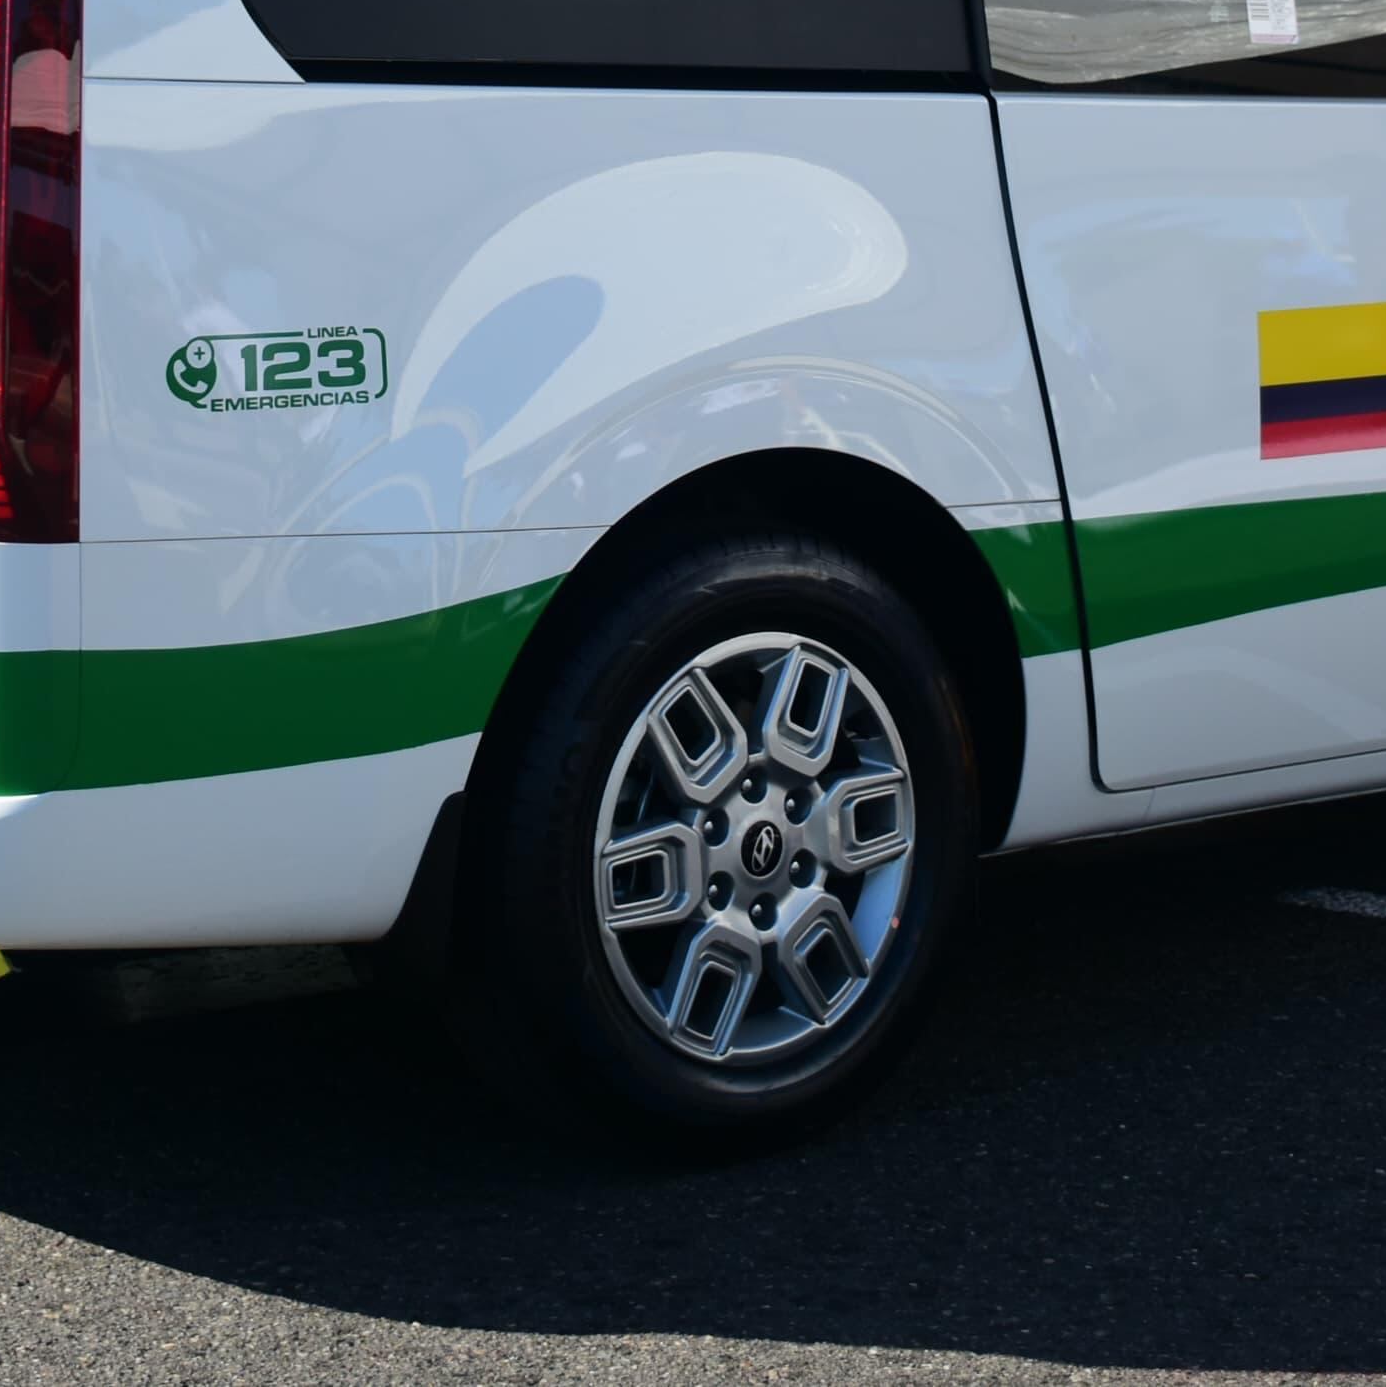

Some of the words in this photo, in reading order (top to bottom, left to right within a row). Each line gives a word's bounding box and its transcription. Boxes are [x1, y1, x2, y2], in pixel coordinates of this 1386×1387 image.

[307, 326, 358, 339] LINEA
[240, 339, 367, 392] 123
[210, 390, 370, 413] EMERGENCIAS
